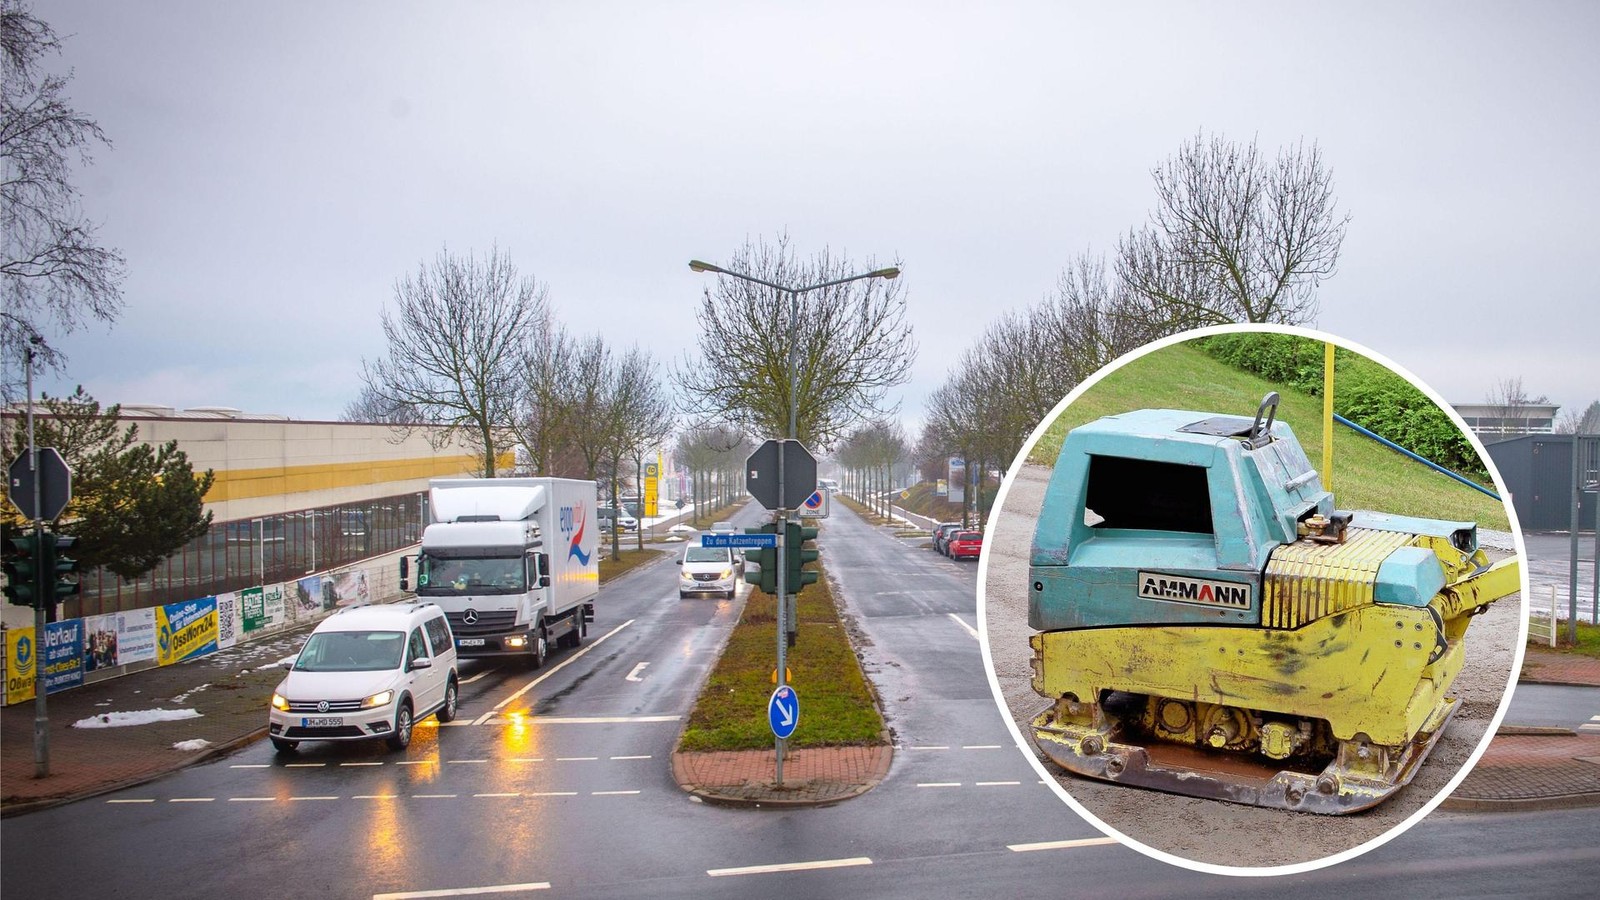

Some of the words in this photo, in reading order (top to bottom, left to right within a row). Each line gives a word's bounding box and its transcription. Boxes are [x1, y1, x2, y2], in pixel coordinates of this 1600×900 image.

[706, 537, 713, 545] Zu
[716, 537, 727, 545] den
[729, 537, 772, 547] Katzentreppen
[1142, 578, 1246, 605] AMMANN
[45, 624, 78, 647] Verkauf
